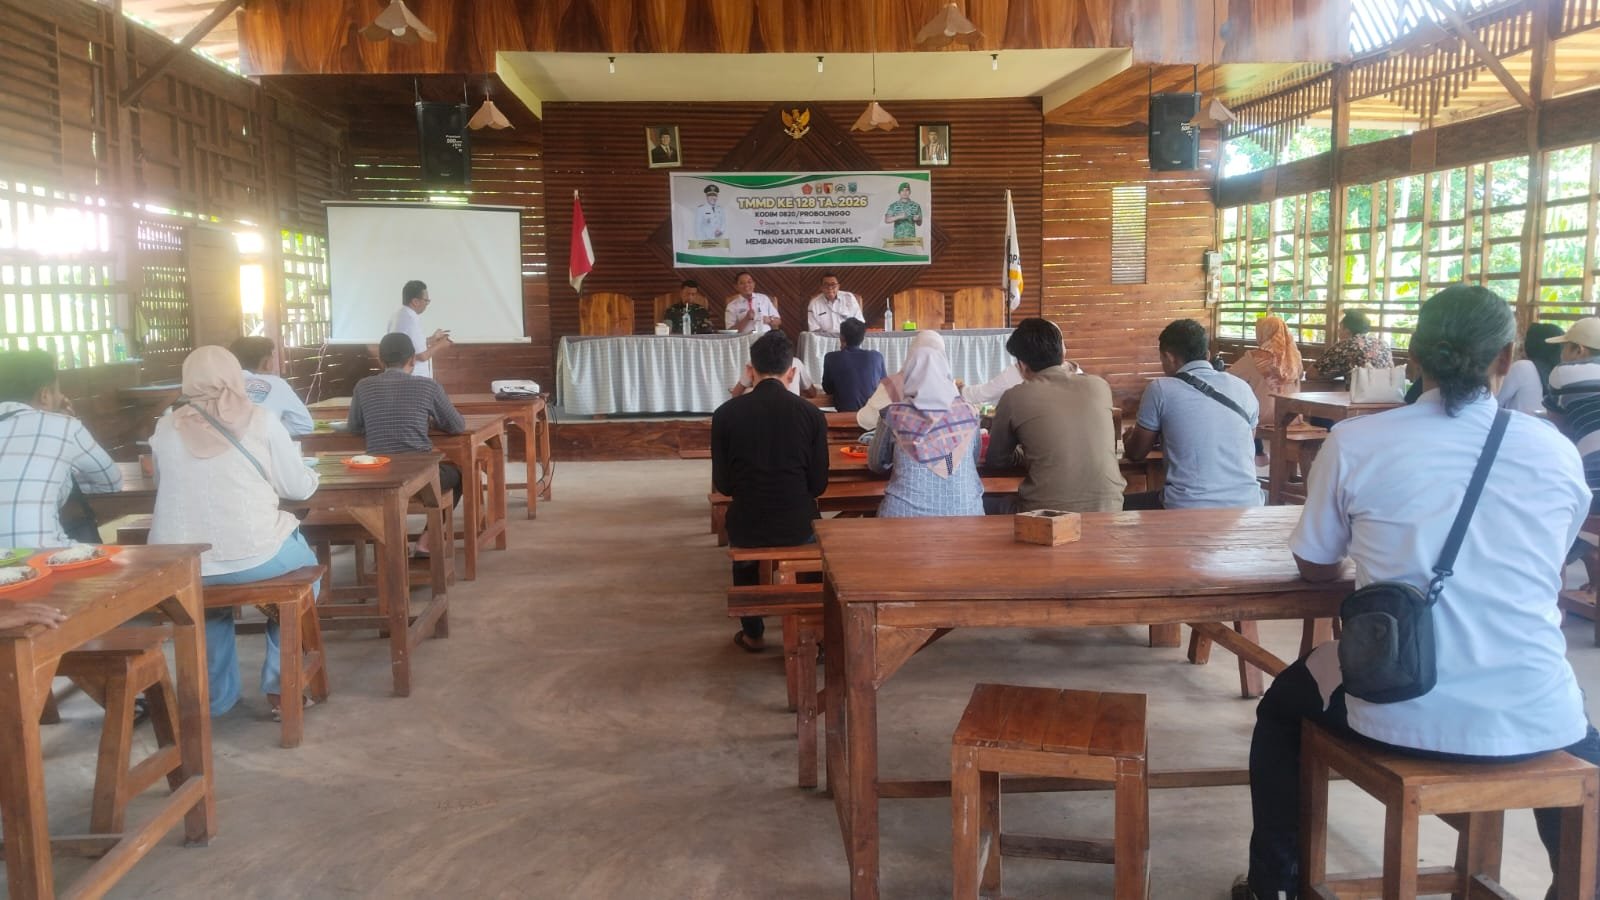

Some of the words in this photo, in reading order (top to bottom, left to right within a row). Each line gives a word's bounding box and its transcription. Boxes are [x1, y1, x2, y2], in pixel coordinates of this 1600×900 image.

[737, 196, 776, 209] TMMD
[776, 196, 795, 209] KE
[795, 196, 816, 208] 128
[838, 195, 868, 208] 2026
